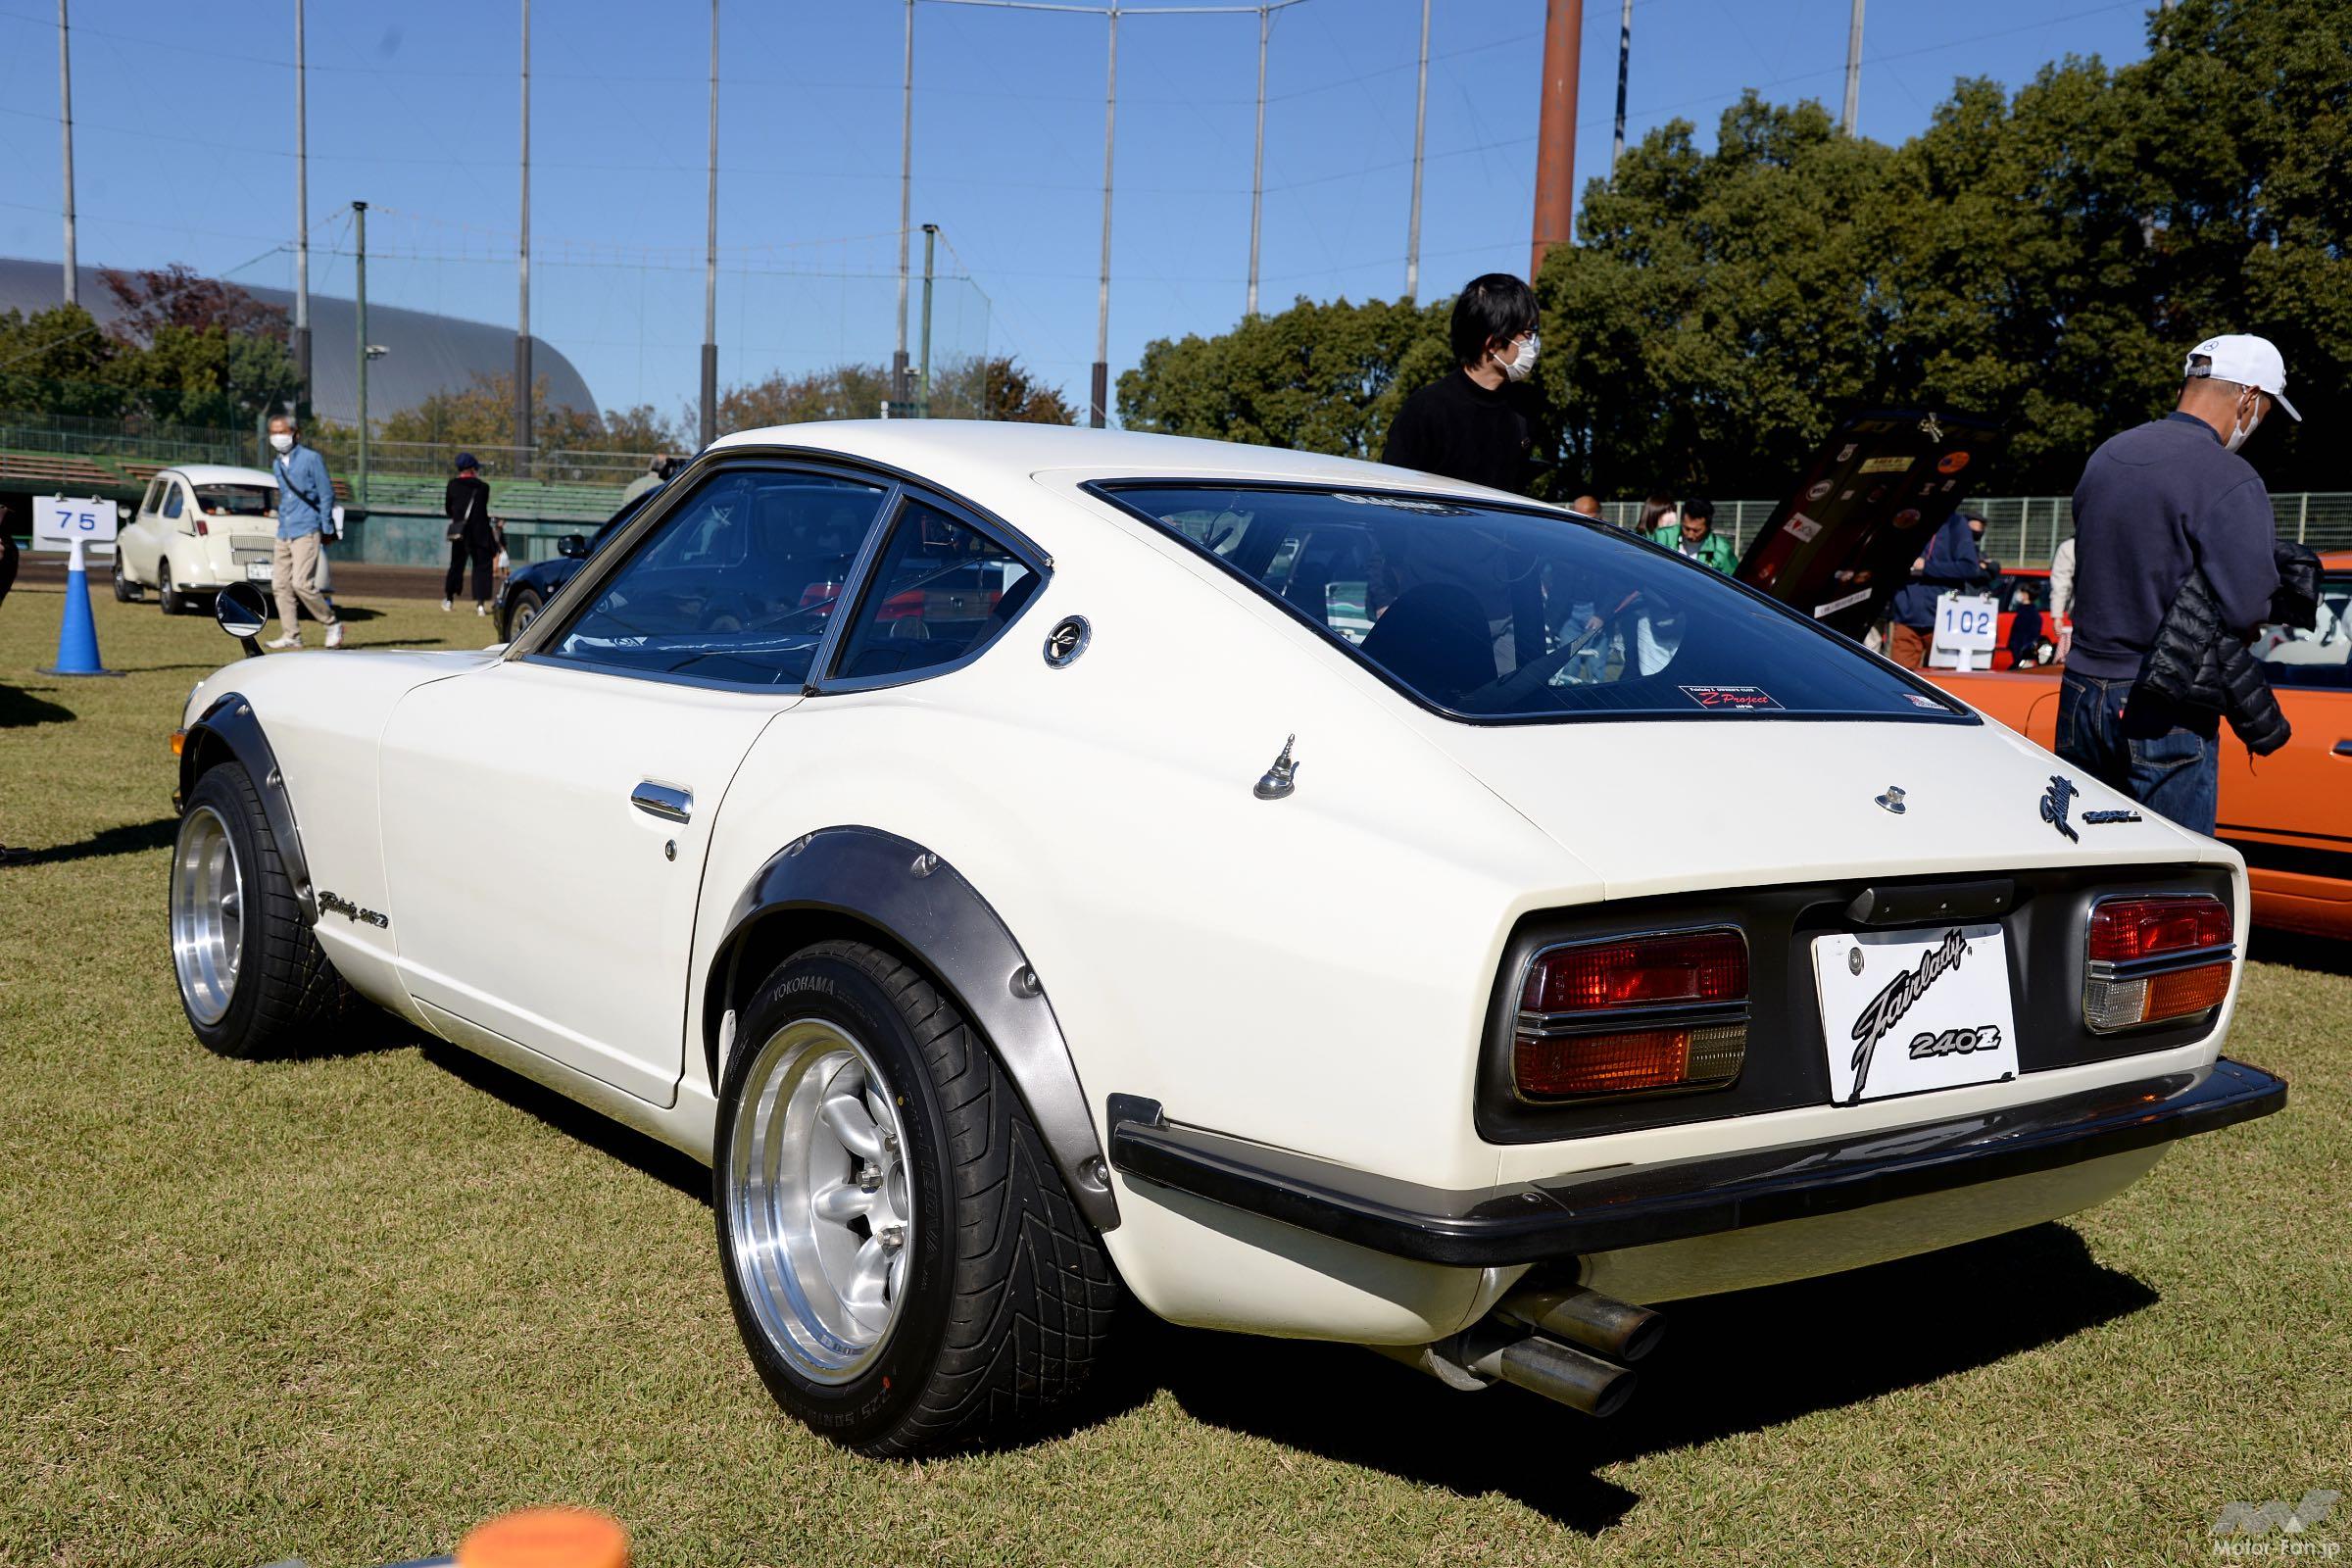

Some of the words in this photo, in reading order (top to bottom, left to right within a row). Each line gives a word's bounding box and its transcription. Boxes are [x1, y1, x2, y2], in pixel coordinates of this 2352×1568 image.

[55, 511, 95, 530] 75
[1945, 609, 1989, 635] 102
[1698, 691, 1721, 705] Z
[1721, 693, 1768, 706] Project
[773, 975, 834, 1002] YOKOHAMA
[1851, 928, 1967, 1094] Fairlady
[1909, 1025, 2001, 1059] 240Z
